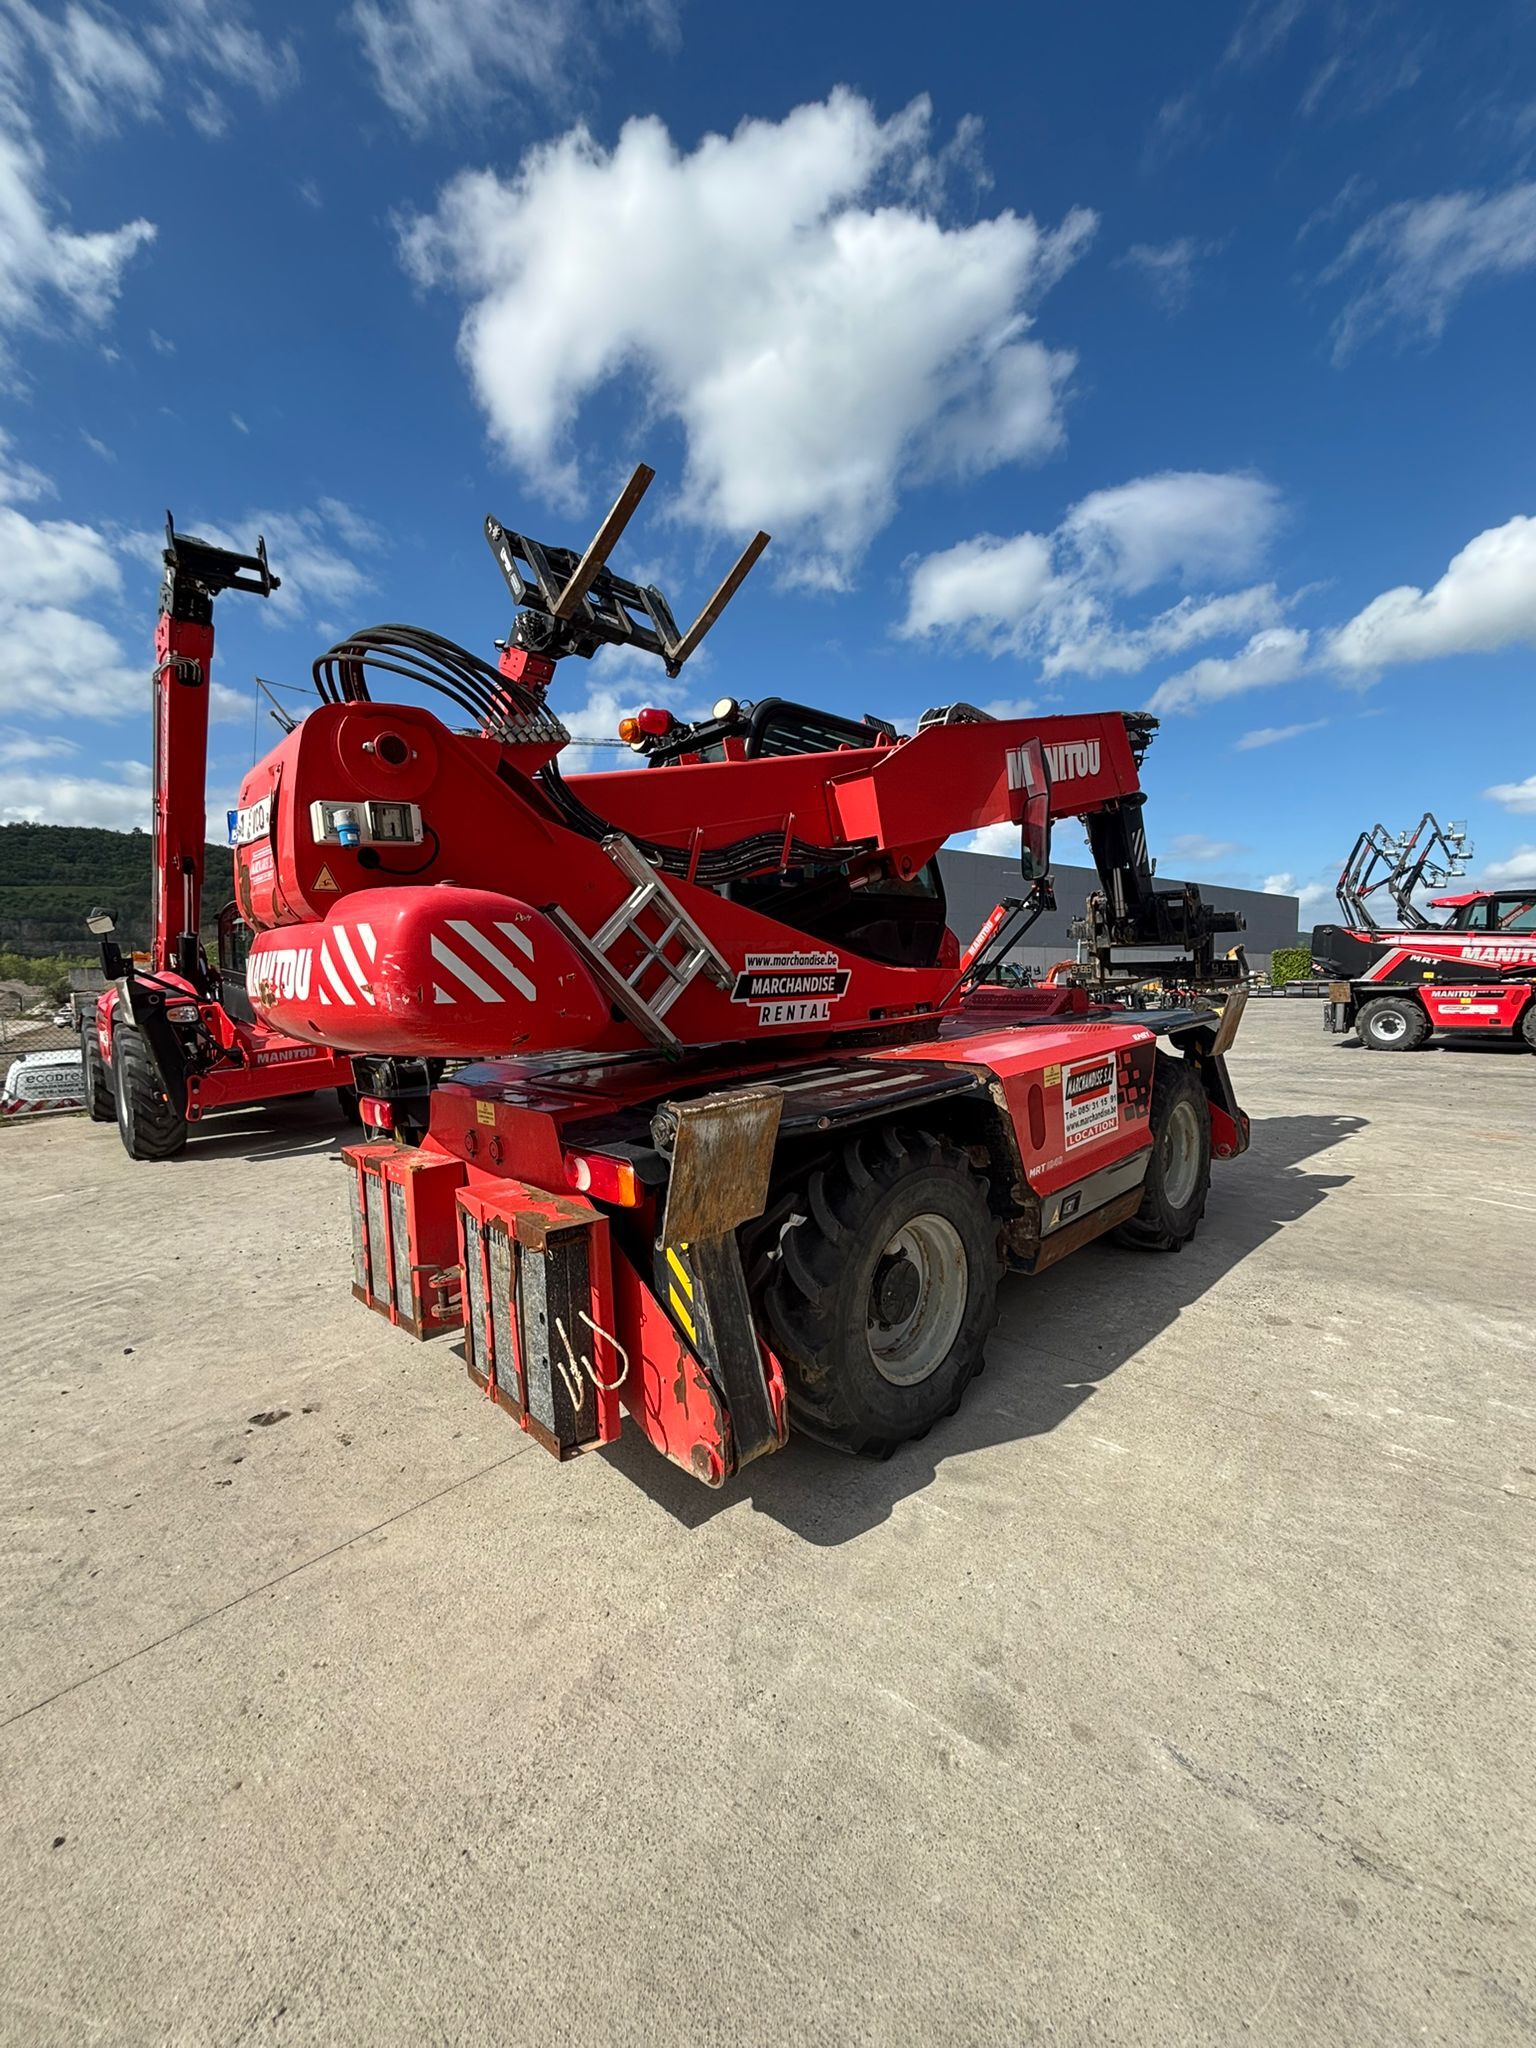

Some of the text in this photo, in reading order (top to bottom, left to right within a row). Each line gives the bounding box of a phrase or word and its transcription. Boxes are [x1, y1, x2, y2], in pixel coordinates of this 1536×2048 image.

[1005, 738, 1101, 790] MNITOU
[747, 954, 837, 967] www.marchandise.be
[1410, 955, 1441, 965] MRT
[751, 976, 836, 995] MARCHANDISE
[1431, 990, 1477, 998] MANITOU
[761, 1002, 829, 1022] RENTAL
[257, 1048, 317, 1063] MANITOU
[1066, 1105, 1117, 1132] www.marchandise.be
[1069, 1118, 1115, 1145] LOCATION
[1029, 1163, 1047, 1178] MRT
